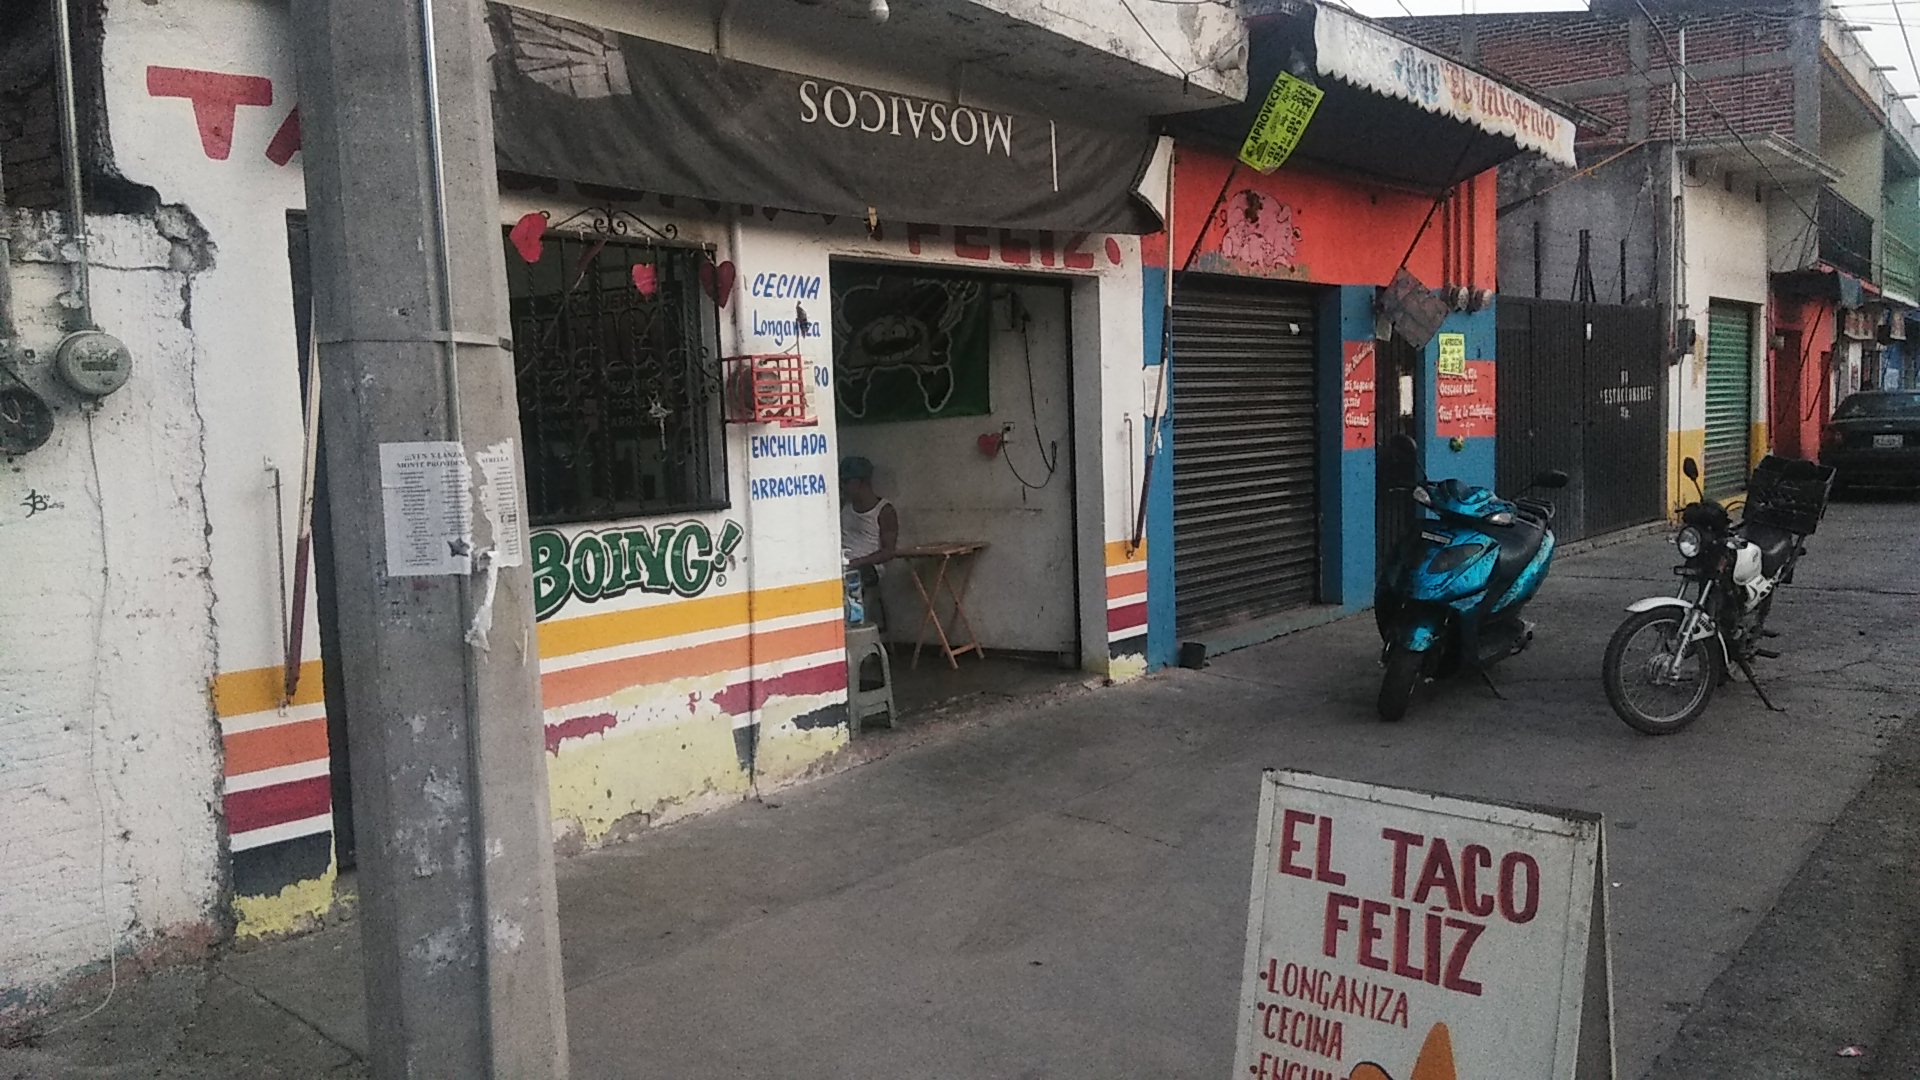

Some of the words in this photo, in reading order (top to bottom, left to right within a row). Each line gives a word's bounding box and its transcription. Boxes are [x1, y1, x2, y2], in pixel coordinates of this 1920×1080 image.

[799, 80, 1013, 157] MOSAICOS
[1250, 79, 1288, 145] APROVECHA
[752, 273, 821, 299] CECINA
[752, 434, 827, 458] ENCHILADA
[752, 474, 826, 500] ARRACHERA
[1278, 808, 1346, 887] EL
[1381, 827, 1540, 924] TACO
[1267, 958, 1408, 1029] LONGANIZA
[1263, 1003, 1343, 1061] CECINA
